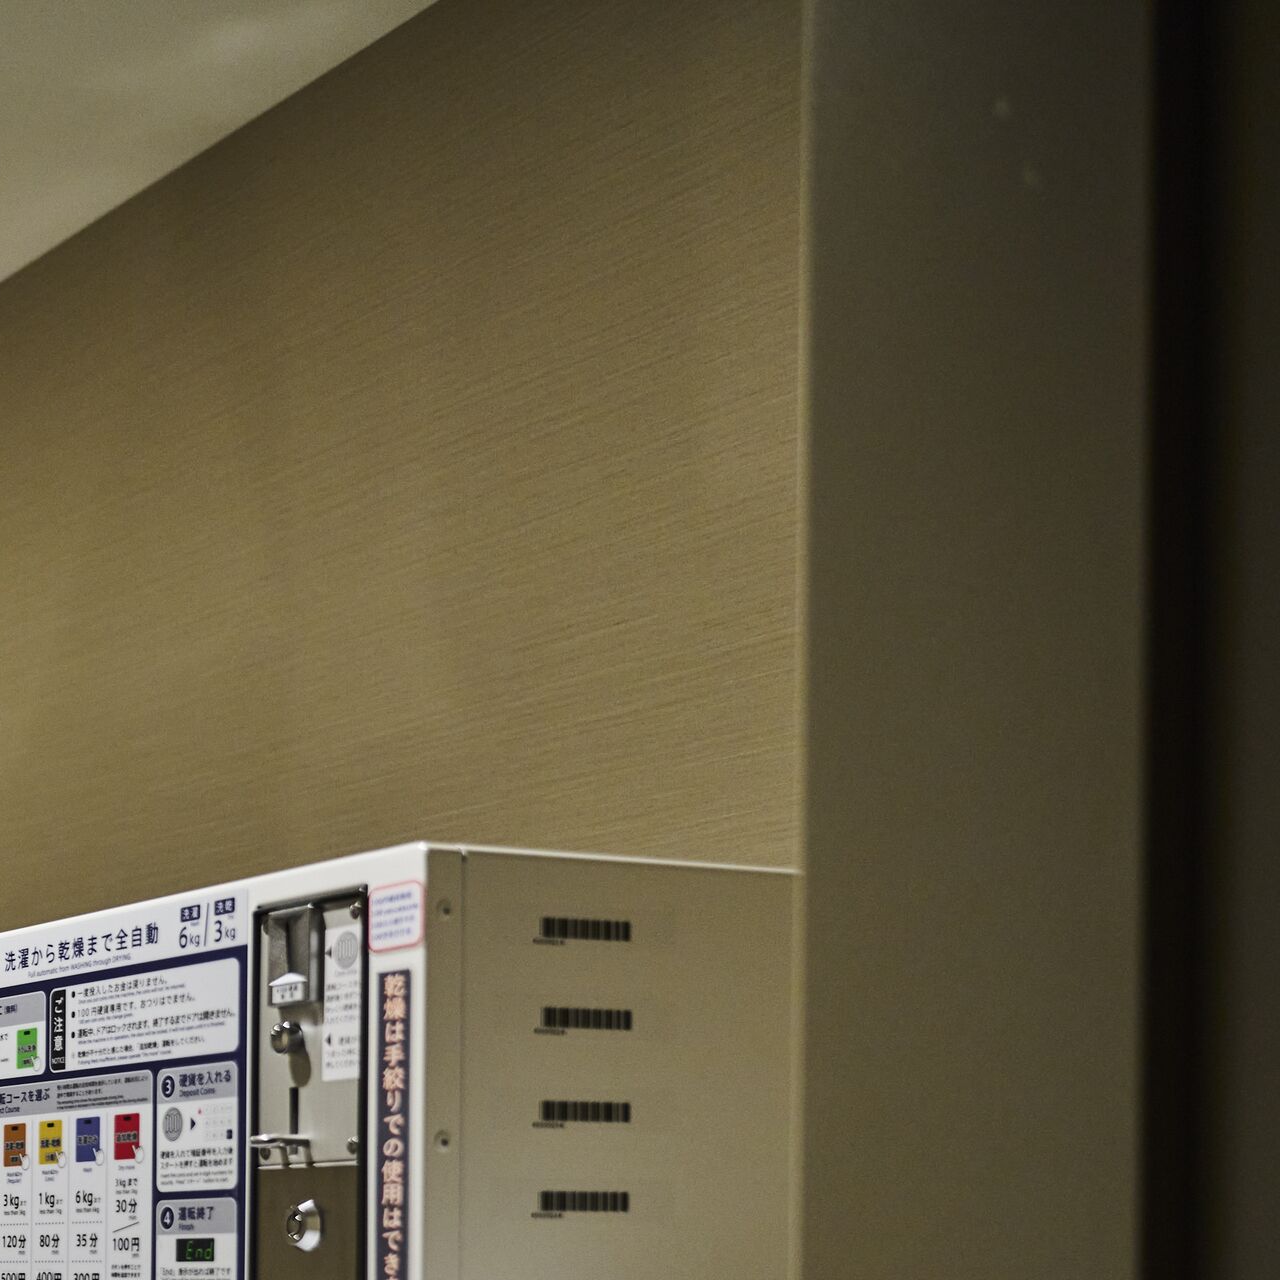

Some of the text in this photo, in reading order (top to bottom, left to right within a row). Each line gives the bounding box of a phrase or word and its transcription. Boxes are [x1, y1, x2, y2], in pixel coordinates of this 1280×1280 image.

[4, 923, 159, 972] 洗濯から乾燥まで全自動
[52, 997, 65, 1051] ご注意
[178, 1070, 232, 1087] 硬貨を入れる
[165, 1079, 172, 1095] 3
[179, 1087, 216, 1098] Deposit Coins
[5, 1104, 20, 1114] Course
[75, 1190, 94, 1206] 6kg
[115, 1198, 138, 1213] 30分
[163, 1210, 171, 1226] 4
[178, 1206, 215, 1222] 運転終了
[2, 1234, 27, 1249] 120分
[39, 1234, 60, 1249] 80分
[76, 1233, 98, 1248] 35分
[112, 1236, 140, 1252] 100円
[185, 1240, 213, 1261] End
